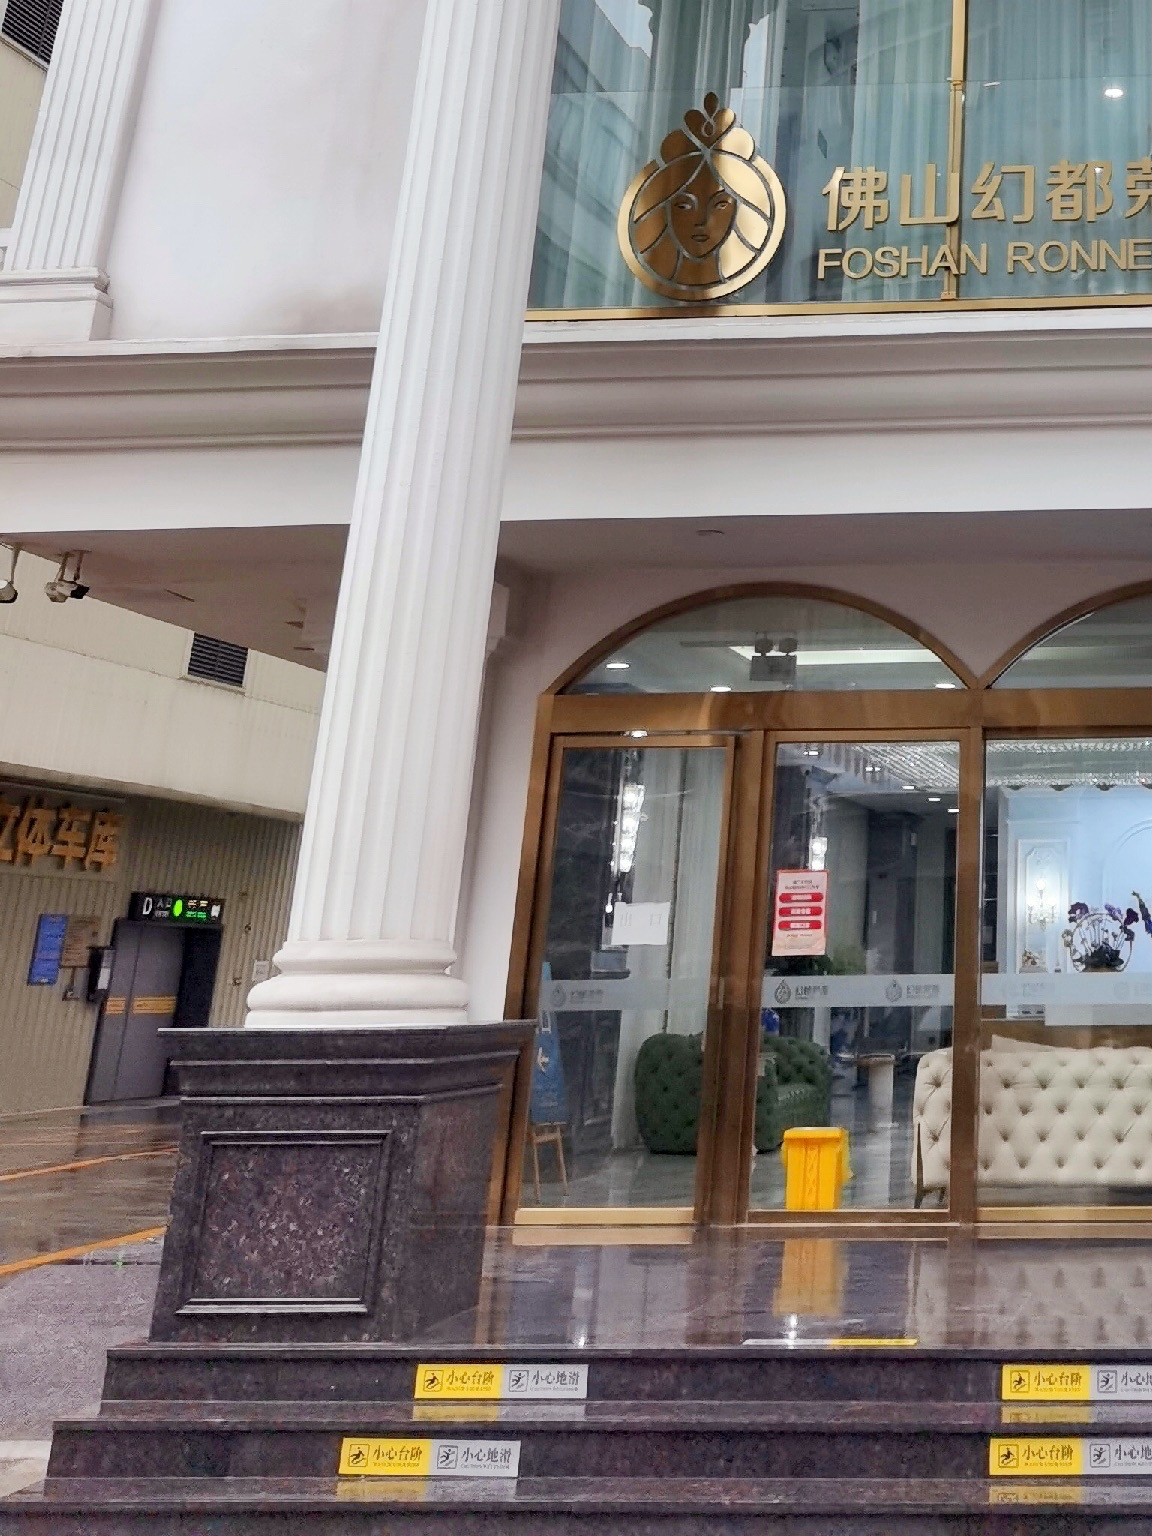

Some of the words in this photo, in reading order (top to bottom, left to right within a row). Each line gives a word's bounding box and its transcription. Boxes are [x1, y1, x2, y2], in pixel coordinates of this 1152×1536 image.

[817, 241, 988, 279] FOSHAN
[1006, 238, 1152, 273] RONNE
[446, 1369, 495, 1386] 小心台阶
[532, 1369, 580, 1386] 小心地滑
[1034, 1371, 1082, 1386] 小心台阶
[373, 1445, 422, 1462] 小心台阶
[461, 1447, 512, 1463] 小心地滑
[1022, 1444, 1074, 1461] 小心台阶
